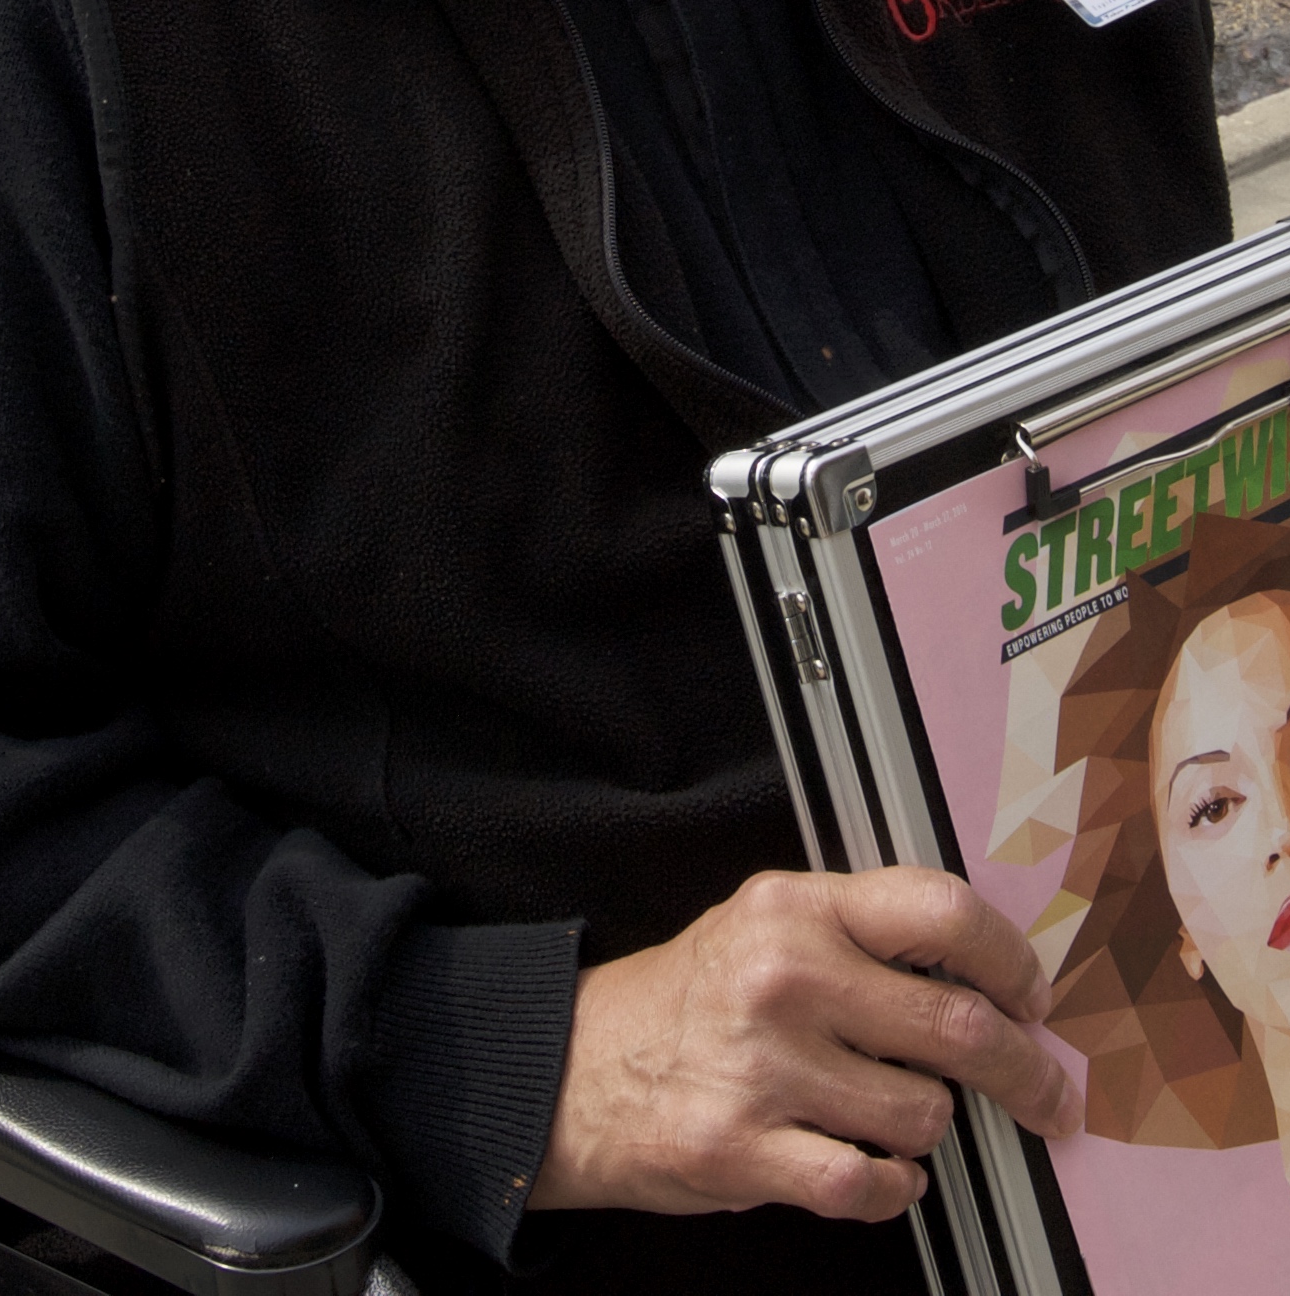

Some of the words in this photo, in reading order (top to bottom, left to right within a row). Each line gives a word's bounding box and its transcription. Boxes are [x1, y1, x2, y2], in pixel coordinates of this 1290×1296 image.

[890, 532, 909, 547] March
[923, 516, 942, 532] March
[1006, 618, 1064, 657] EMPOWERING
[1064, 601, 1099, 628] PEOPLE
[1101, 593, 1114, 609] TO
[1114, 585, 1129, 602] WO
